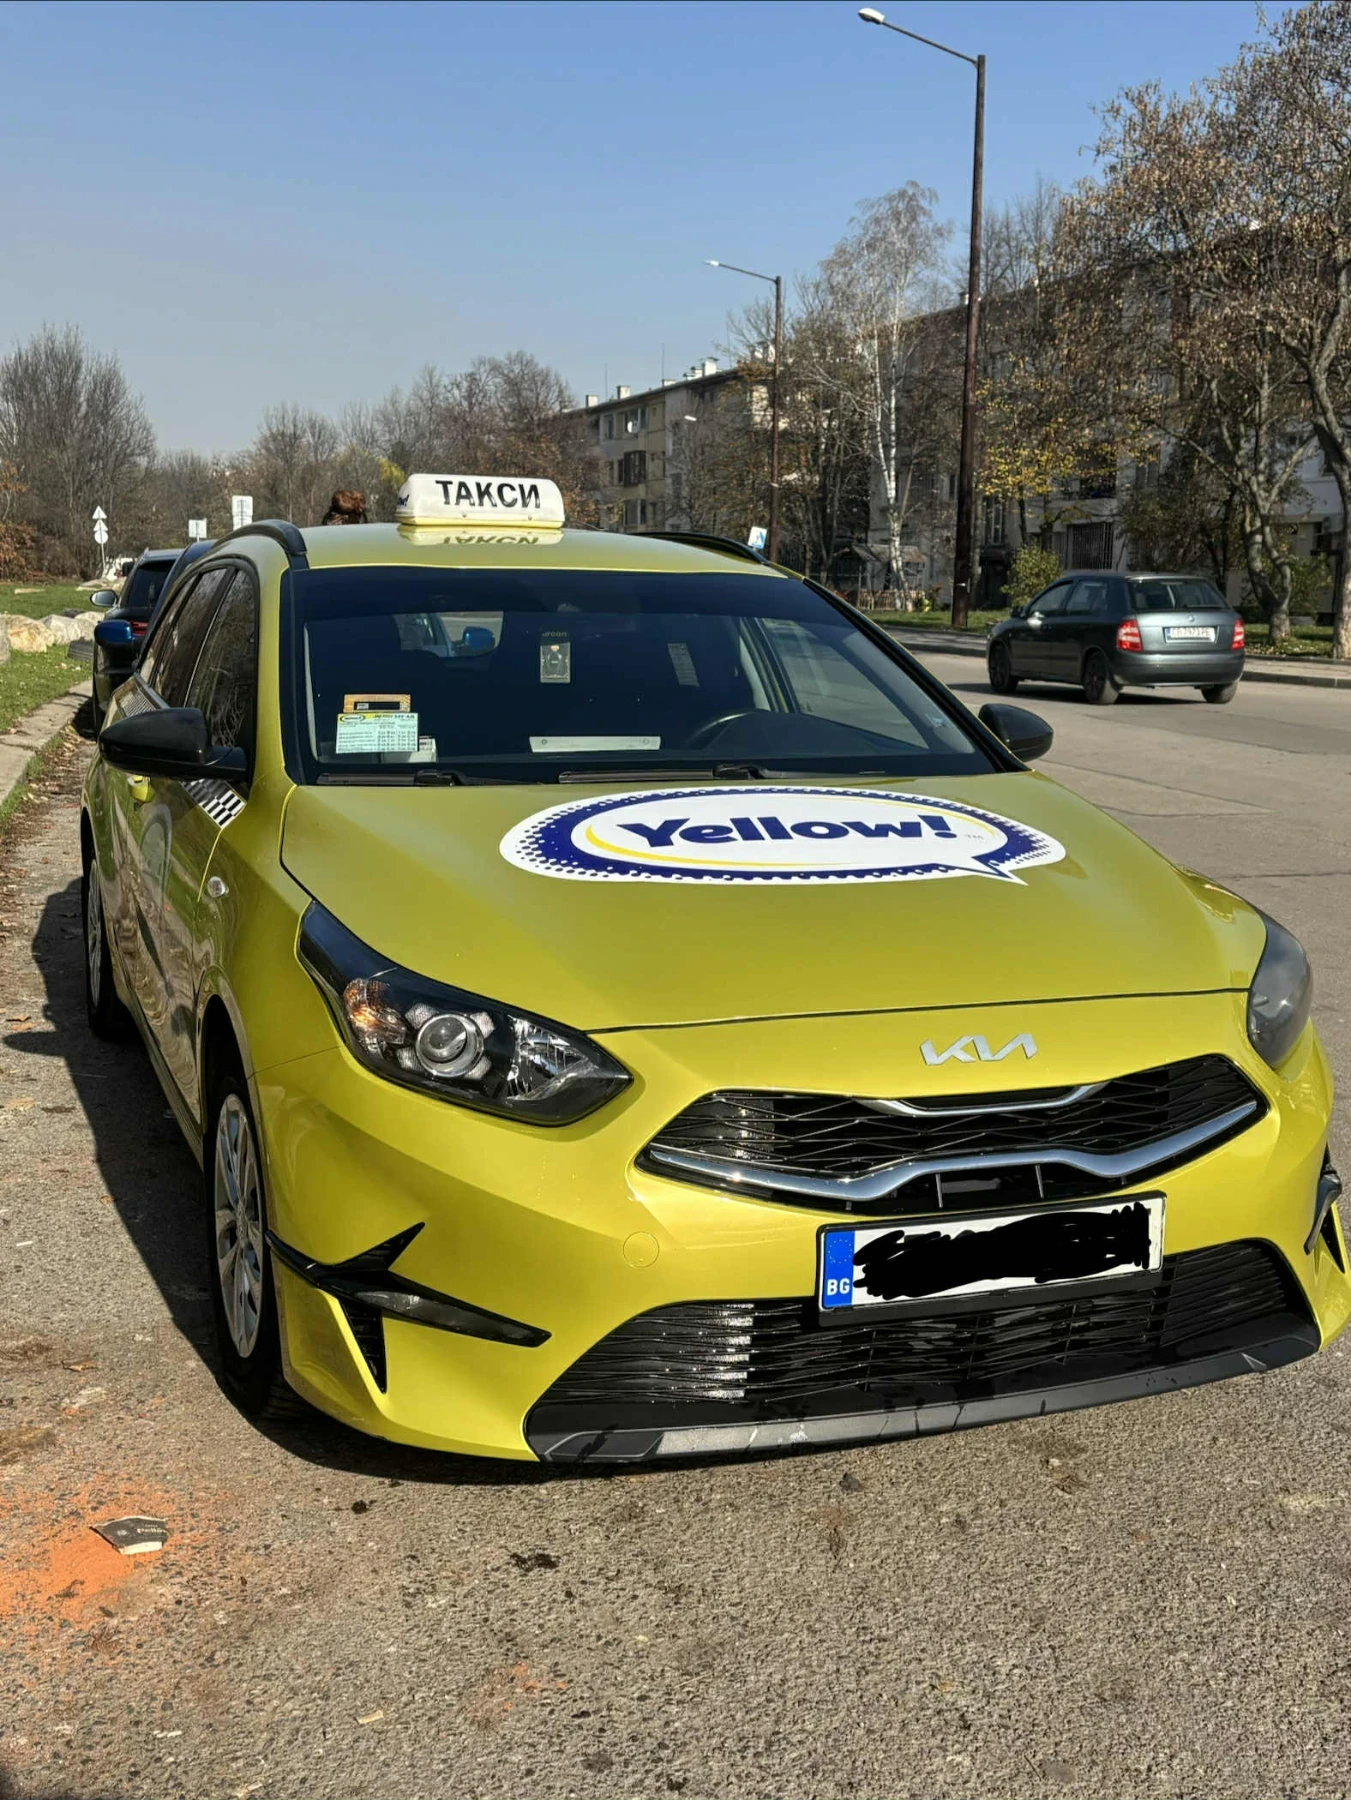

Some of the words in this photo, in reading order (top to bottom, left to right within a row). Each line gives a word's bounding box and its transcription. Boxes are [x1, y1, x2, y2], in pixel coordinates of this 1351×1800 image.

[435, 480, 541, 508] ТАКСИ
[616, 814, 958, 848] Yellow!
[827, 1277, 850, 1296] BG
